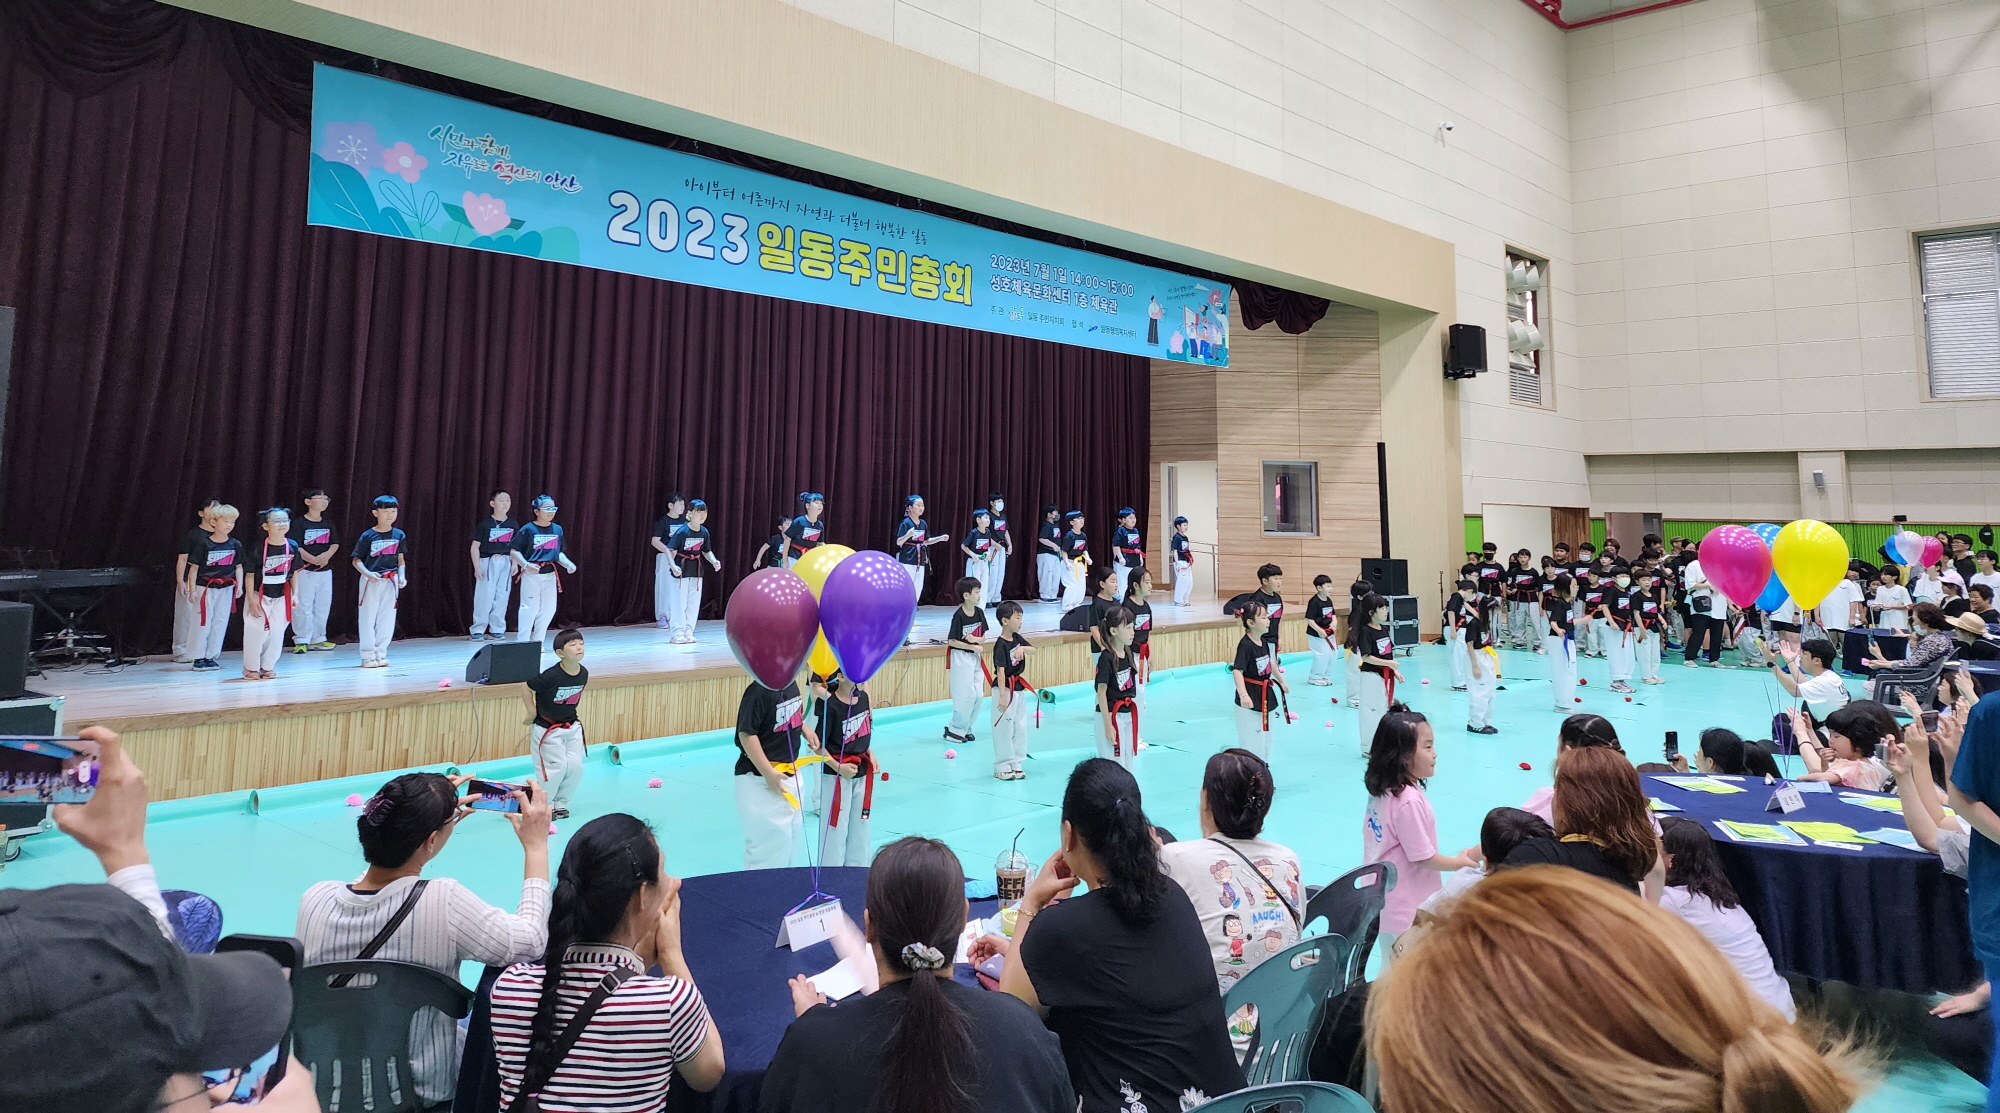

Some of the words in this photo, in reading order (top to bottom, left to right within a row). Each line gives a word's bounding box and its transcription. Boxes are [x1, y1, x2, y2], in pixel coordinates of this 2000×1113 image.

[428, 123, 477, 152] 시민과
[442, 151, 490, 179] 자유로운
[492, 160, 541, 185] 혁신도시
[543, 171, 582, 194] 안산
[685, 177, 735, 200] 아이부터
[742, 192, 790, 212] 어른까지
[796, 203, 835, 223] 자연과
[840, 212, 870, 232] 더불어
[875, 219, 907, 240] 행복한
[911, 228, 927, 246] 일동
[607, 190, 749, 265] 2023
[757, 221, 973, 306] 일동주민총회
[990, 253, 1030, 277] 2023년
[1033, 263, 1050, 281] 7월
[1053, 267, 1067, 284] 1일
[1070, 271, 1134, 297] 14:00~15:00
[990, 275, 1071, 306] 성호체육문화센터
[1074, 292, 1088, 309] 1층
[1091, 295, 1118, 315] 체육관
[819, 918, 825, 931] 1
[1252, 910, 1285, 925] AAUGH!
